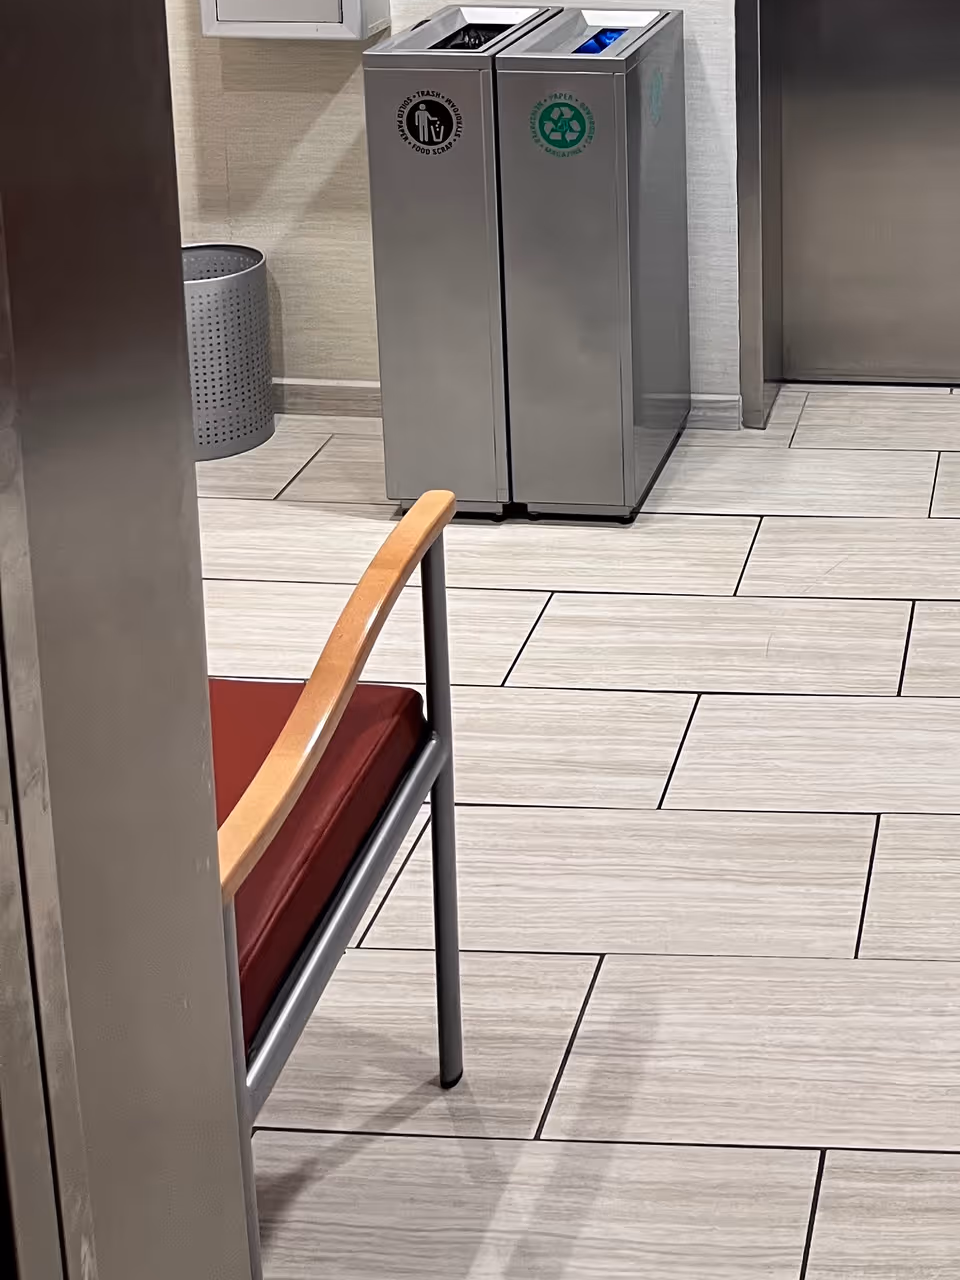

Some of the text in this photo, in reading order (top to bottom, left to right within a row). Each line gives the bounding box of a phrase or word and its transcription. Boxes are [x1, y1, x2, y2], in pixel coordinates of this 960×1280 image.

[416, 90, 441, 99] TRASH
[397, 96, 463, 156] SOILED PAPER FOOD SCRAP STYROFOAM
